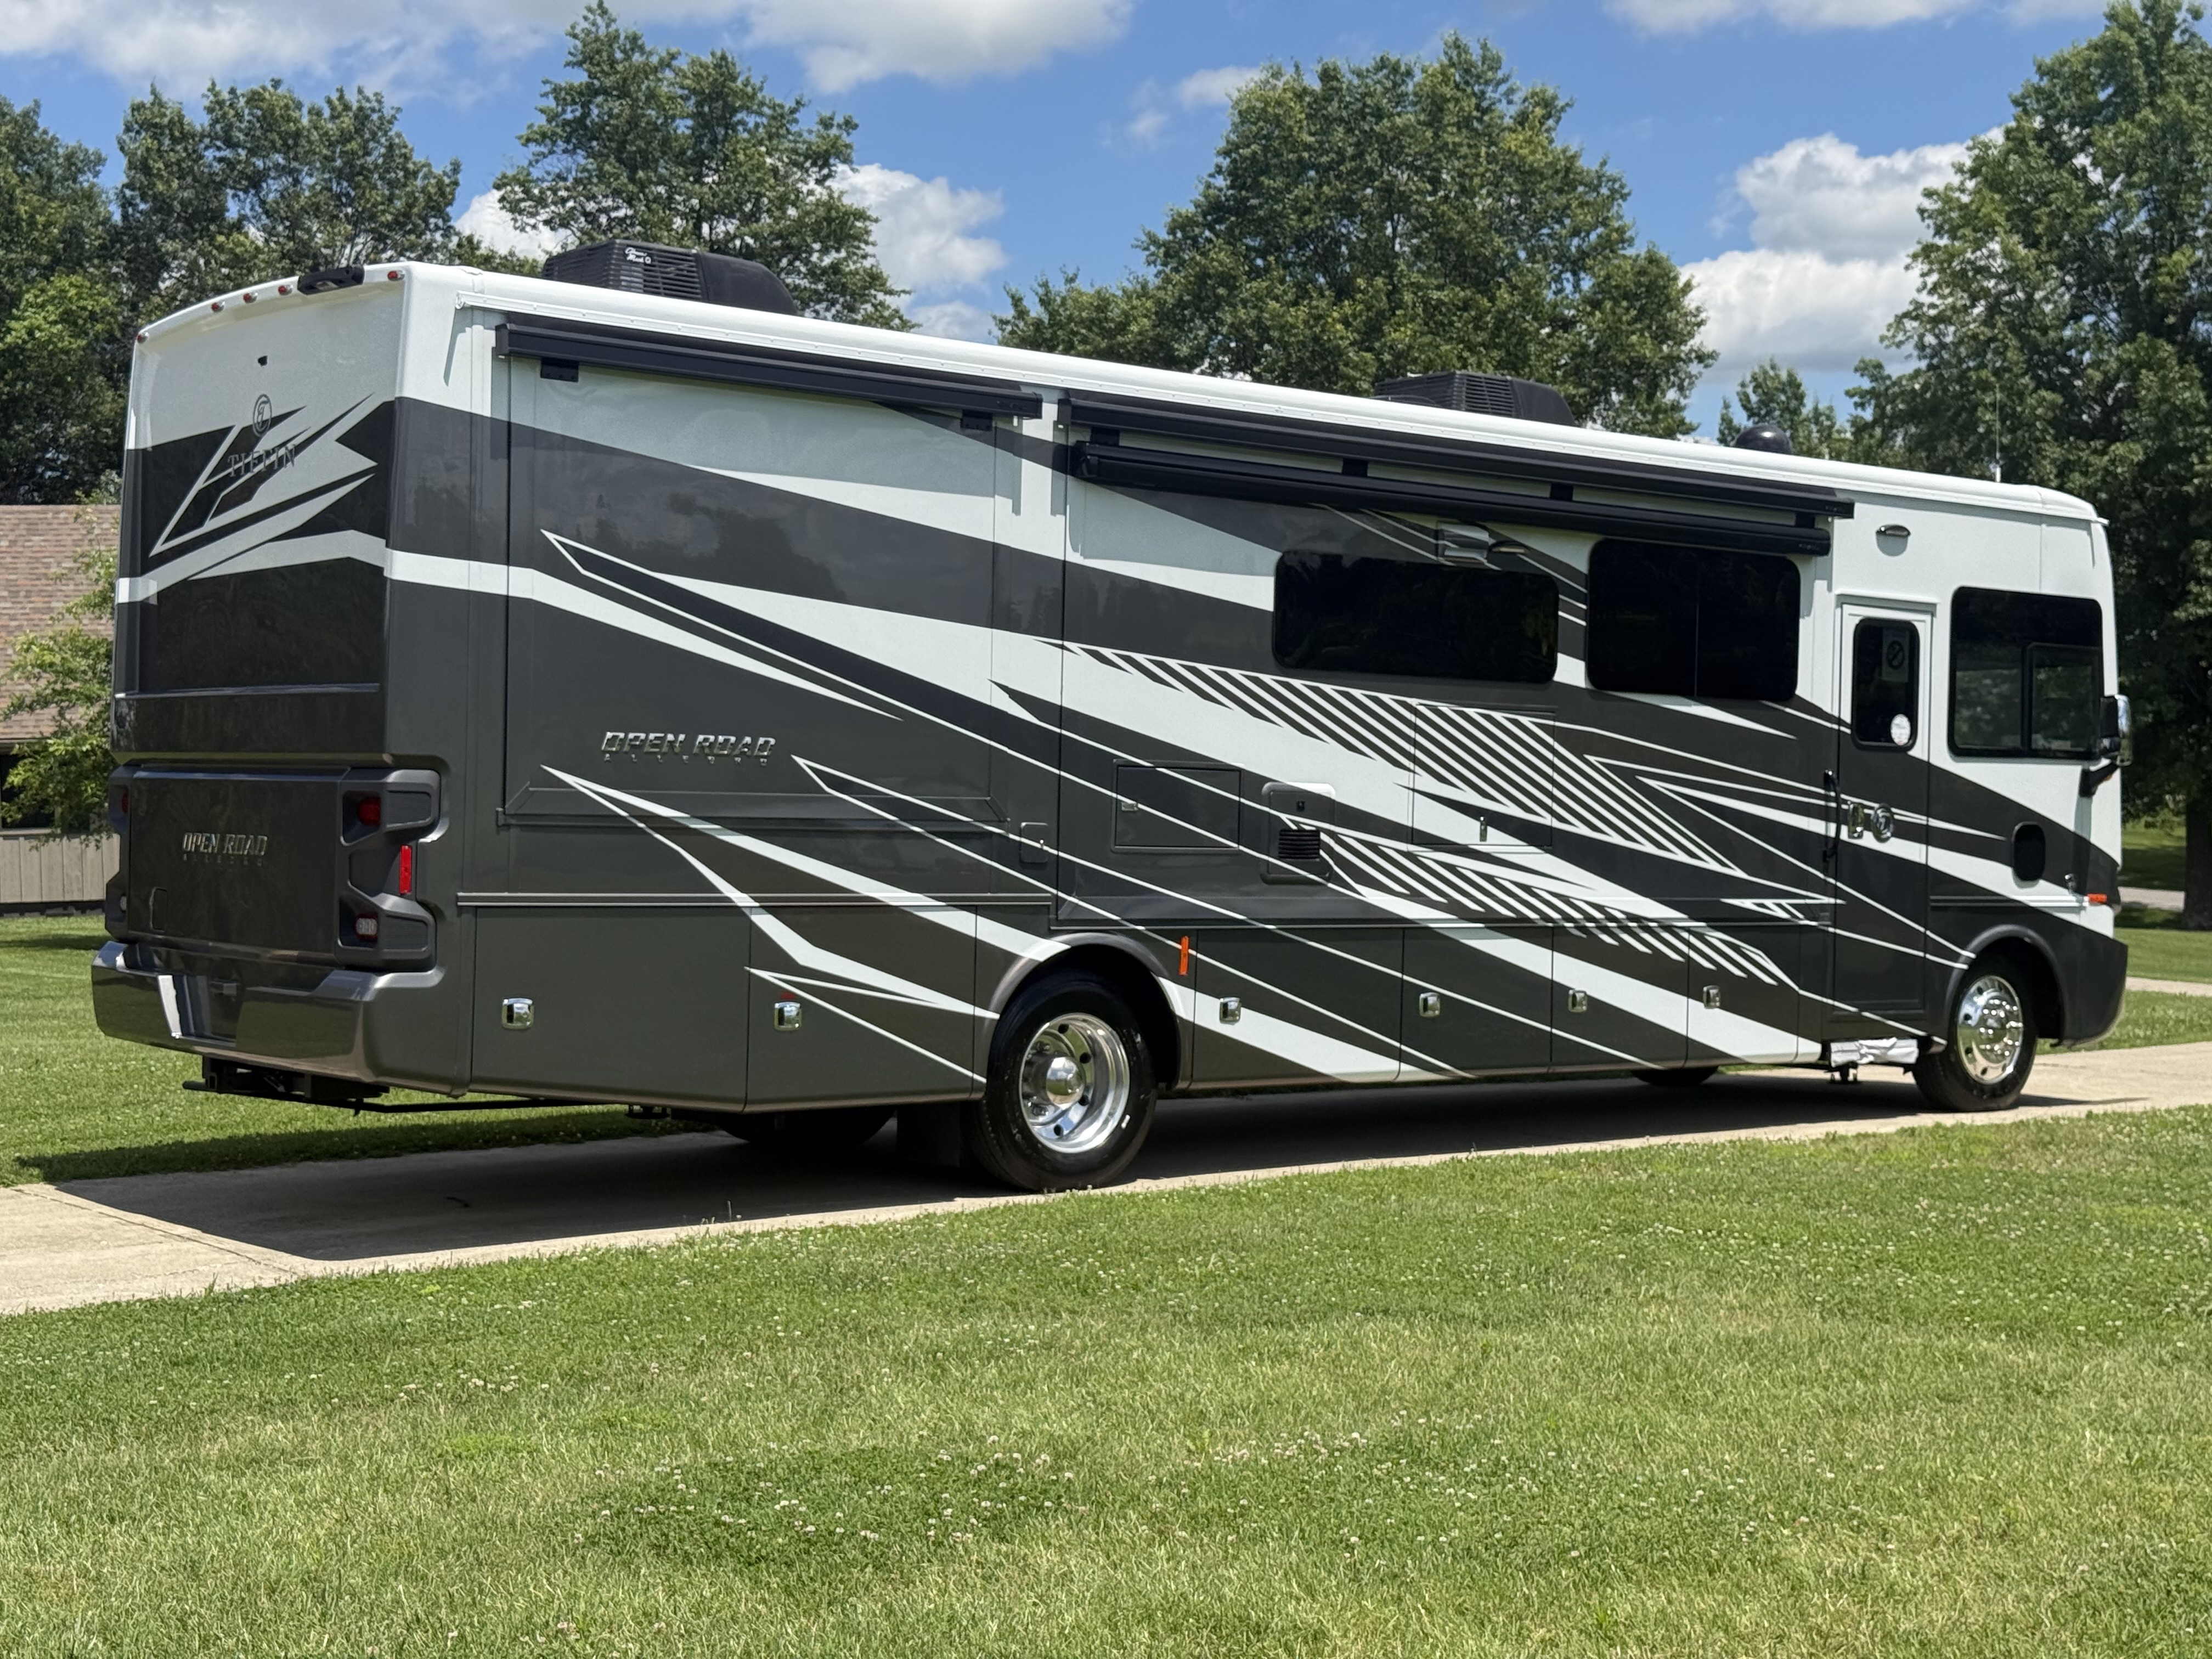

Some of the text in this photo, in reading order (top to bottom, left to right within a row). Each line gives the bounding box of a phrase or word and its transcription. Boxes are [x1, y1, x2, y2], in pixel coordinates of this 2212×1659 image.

[228, 444, 296, 477] TIFFIN
[601, 731, 776, 756] OPEN ROAD
[182, 832, 268, 855] OPEN ROAD
